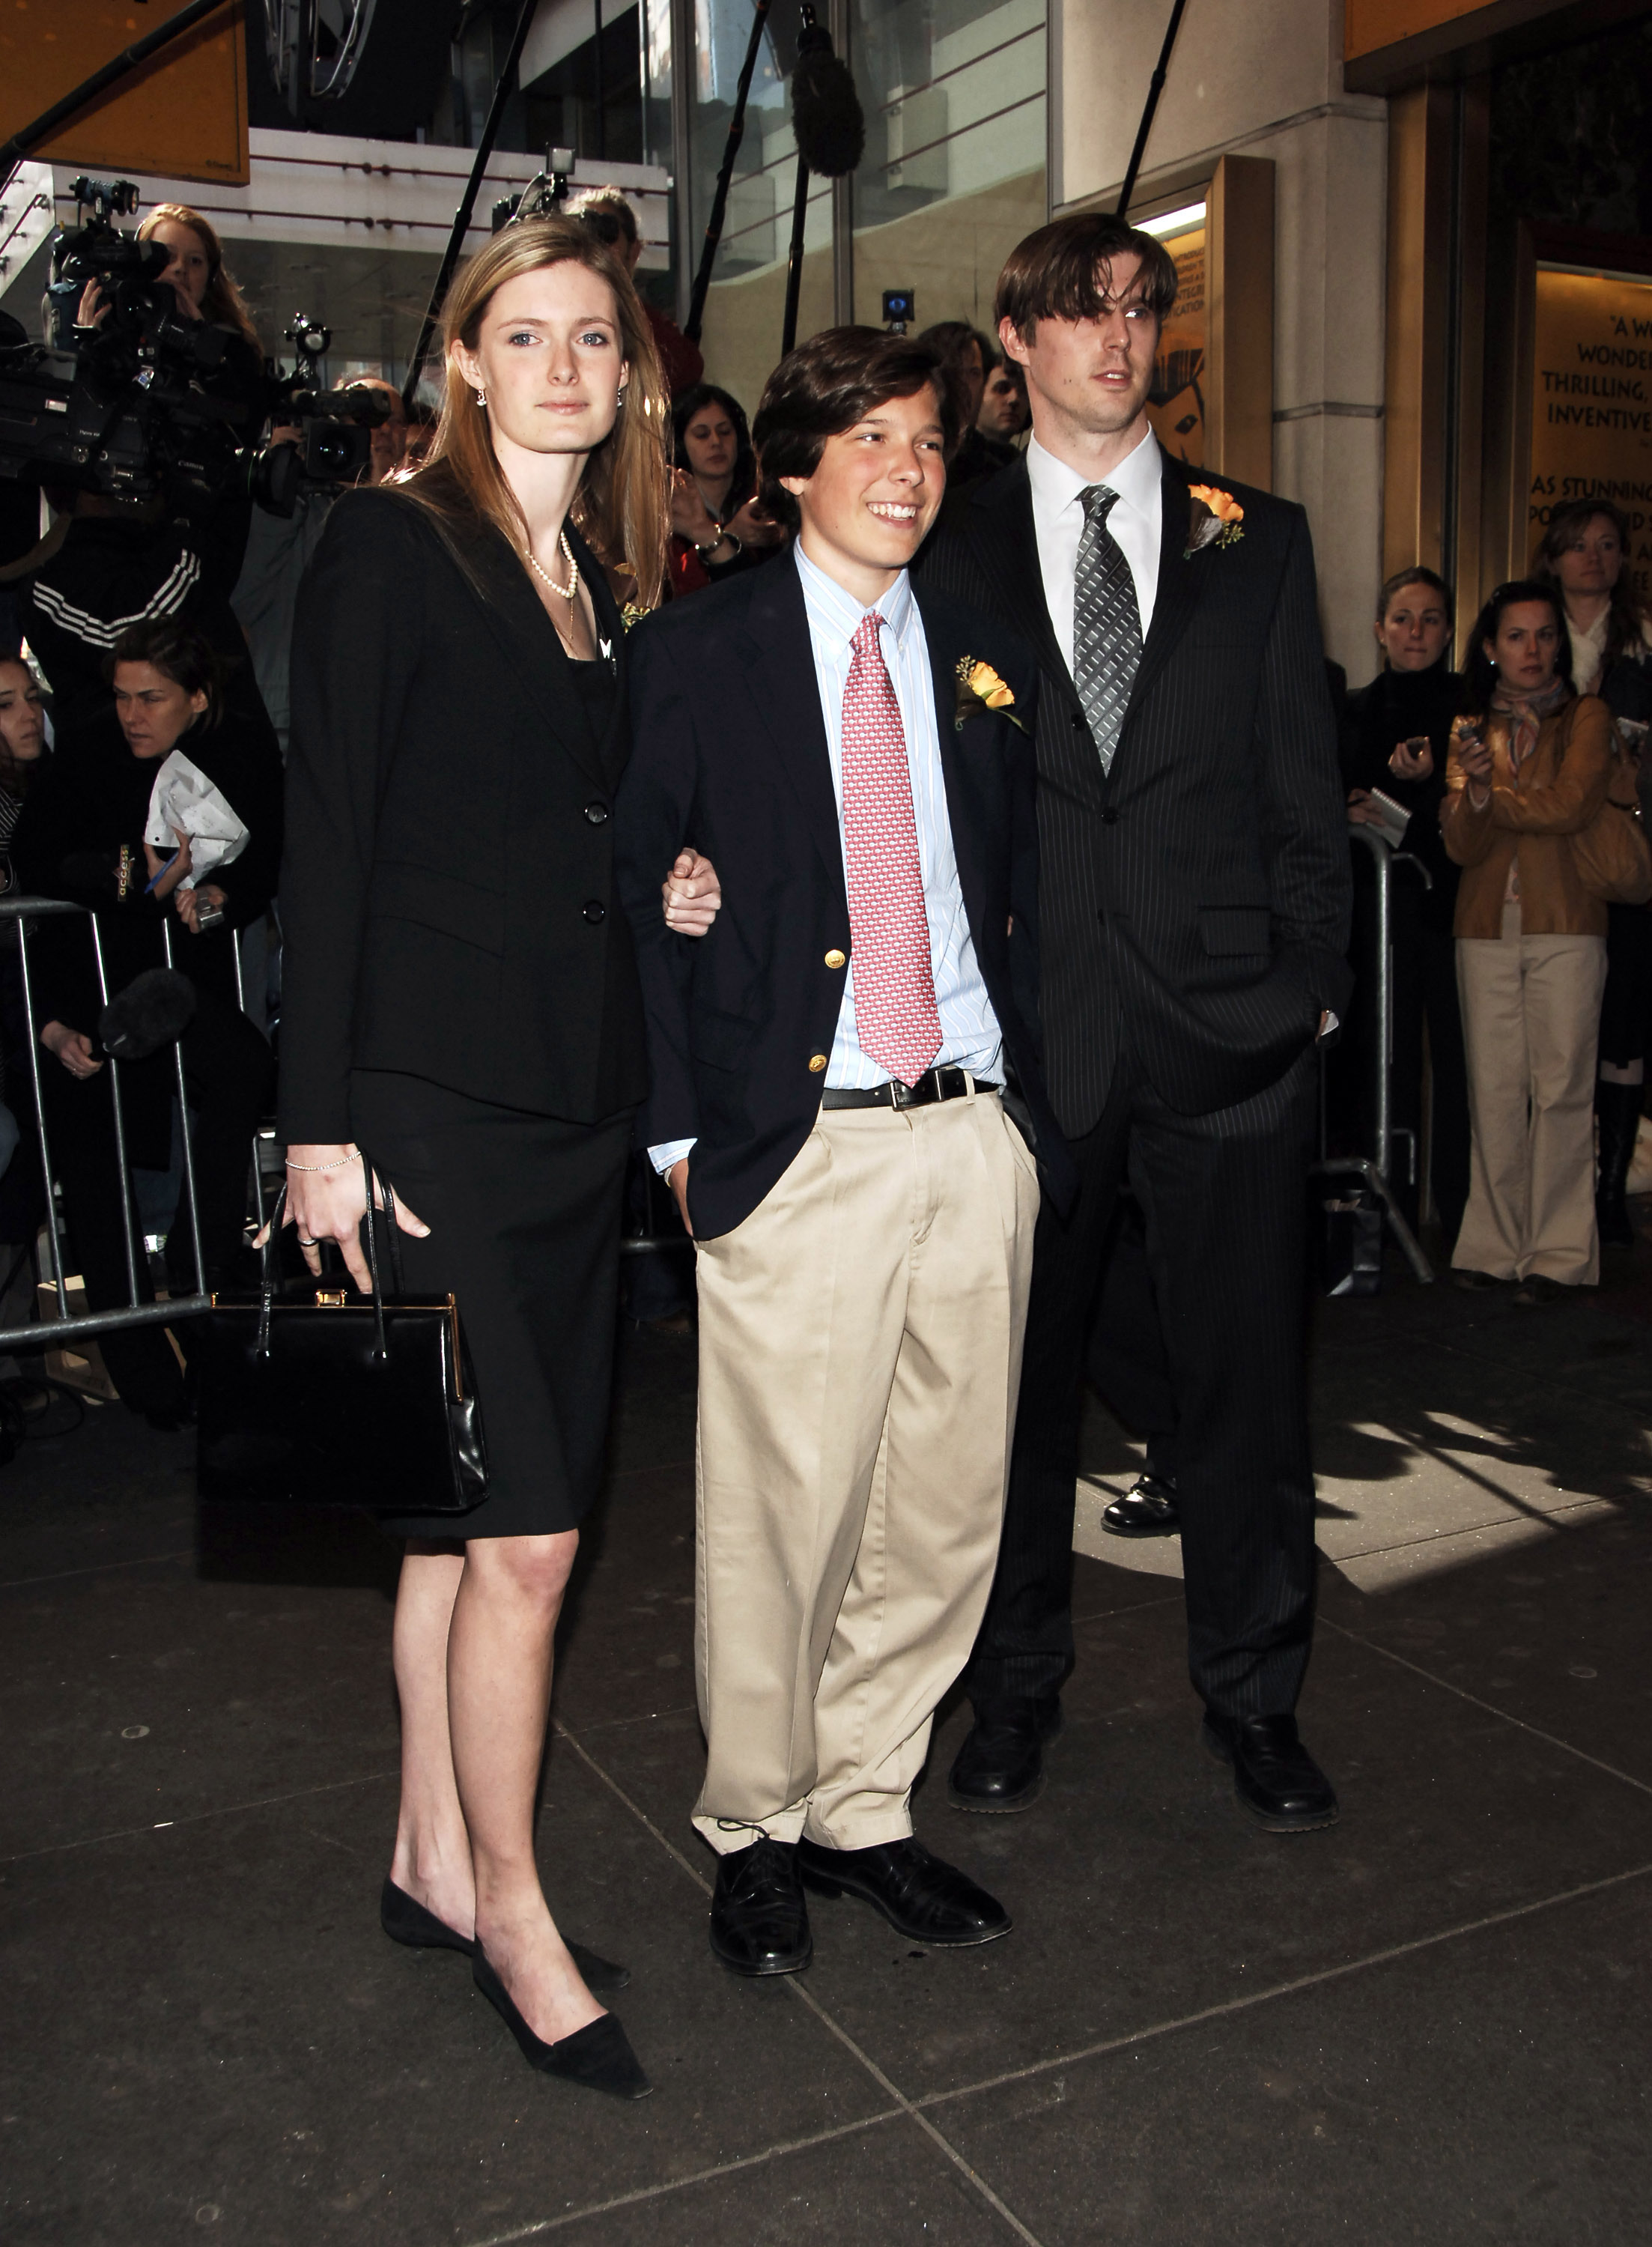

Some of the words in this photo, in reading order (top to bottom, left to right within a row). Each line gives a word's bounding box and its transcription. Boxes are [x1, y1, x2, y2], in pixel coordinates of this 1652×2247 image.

[1577, 343, 1652, 370] WONDE
[1542, 370, 1648, 404] THRILLING,
[1546, 403, 1651, 432] INVENTIVE
[1531, 475, 1555, 495] AS
[120, 849, 129, 895] access
